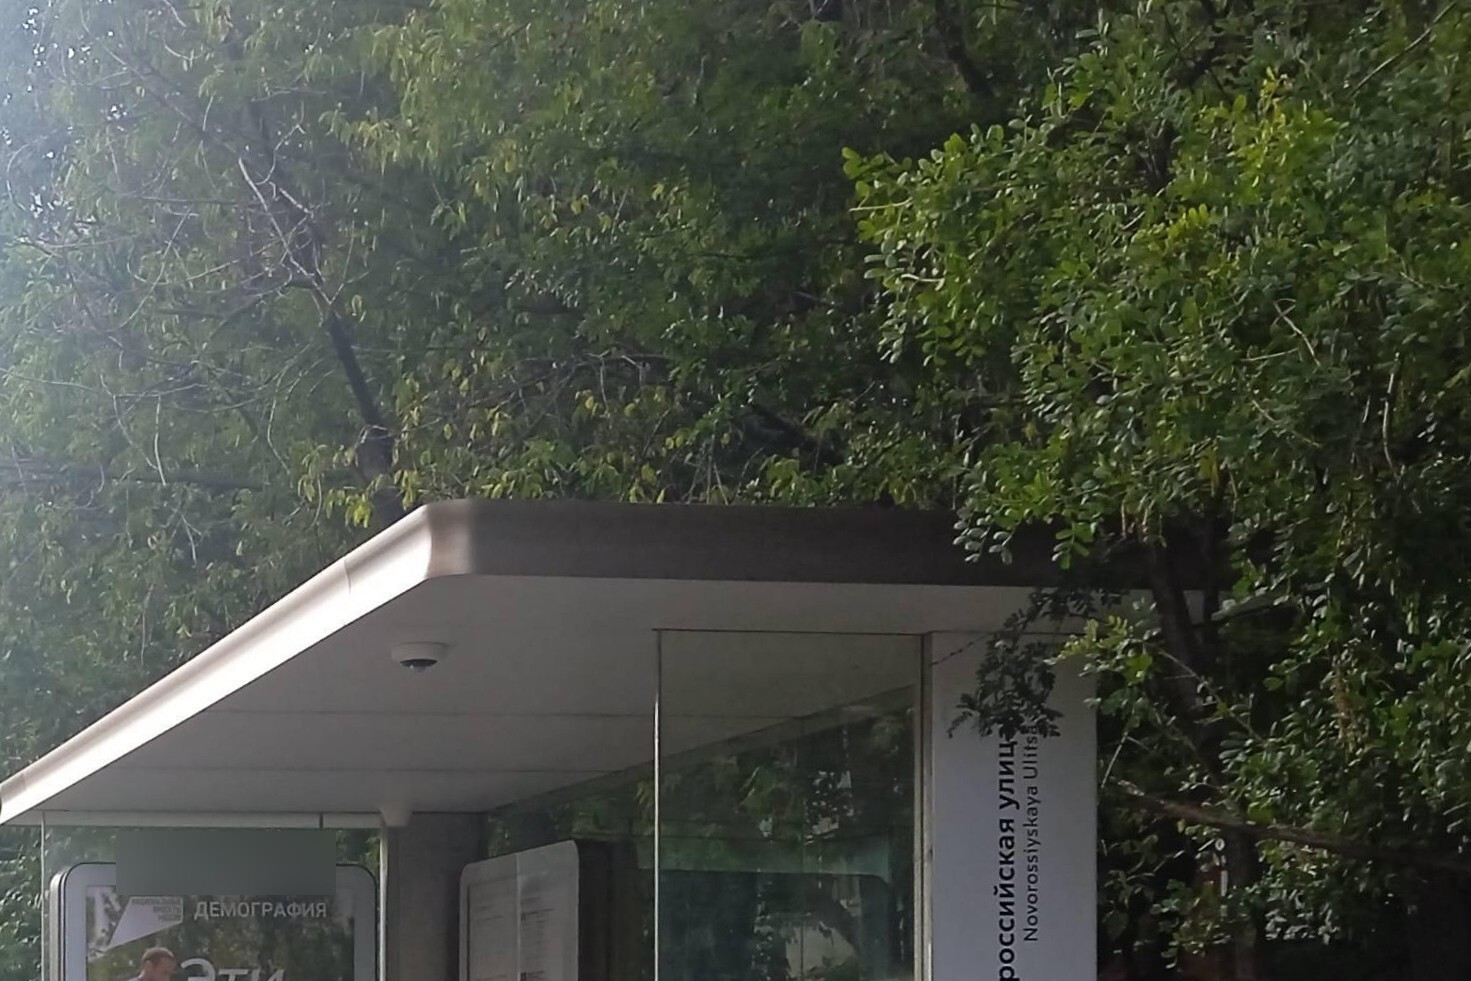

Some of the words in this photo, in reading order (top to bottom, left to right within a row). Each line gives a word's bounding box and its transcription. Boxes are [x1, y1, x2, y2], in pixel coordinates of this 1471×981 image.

[998, 727, 1020, 810] улиц
[1022, 786, 1041, 942] Novorossiyskaya
[194, 901, 327, 920] ДЕМОГРАФИЯ
